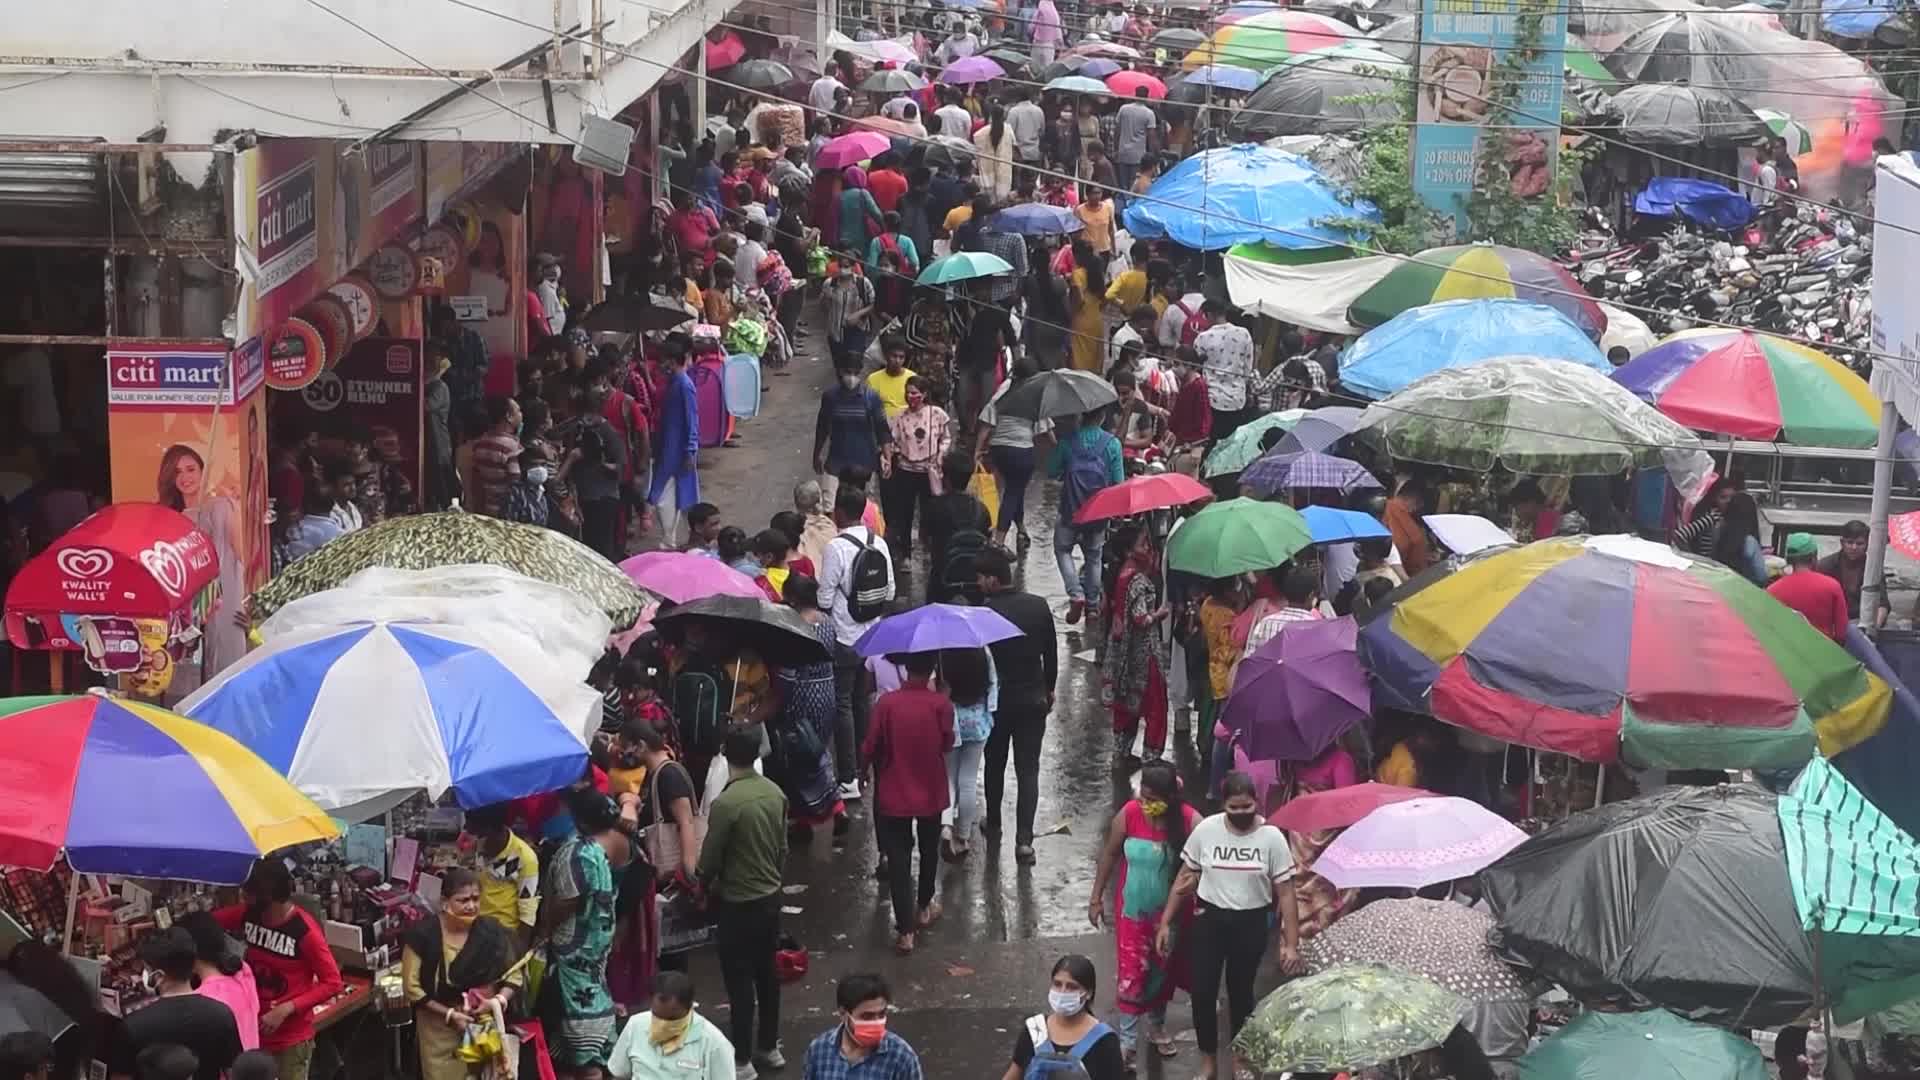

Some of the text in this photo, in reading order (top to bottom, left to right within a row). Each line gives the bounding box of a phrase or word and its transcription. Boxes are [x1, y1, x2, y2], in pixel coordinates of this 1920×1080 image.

[1425, 151, 1474, 166] 20 FRIENDS
[1455, 168, 1473, 184] OFF
[260, 191, 281, 249] citi
[286, 187, 312, 234] mart
[116, 358, 221, 383] citi mart
[347, 380, 412, 393] STUNNER
[62, 581, 111, 590] KWALITY
[67, 591, 105, 601] WALL'S
[1213, 846, 1262, 862] NASA
